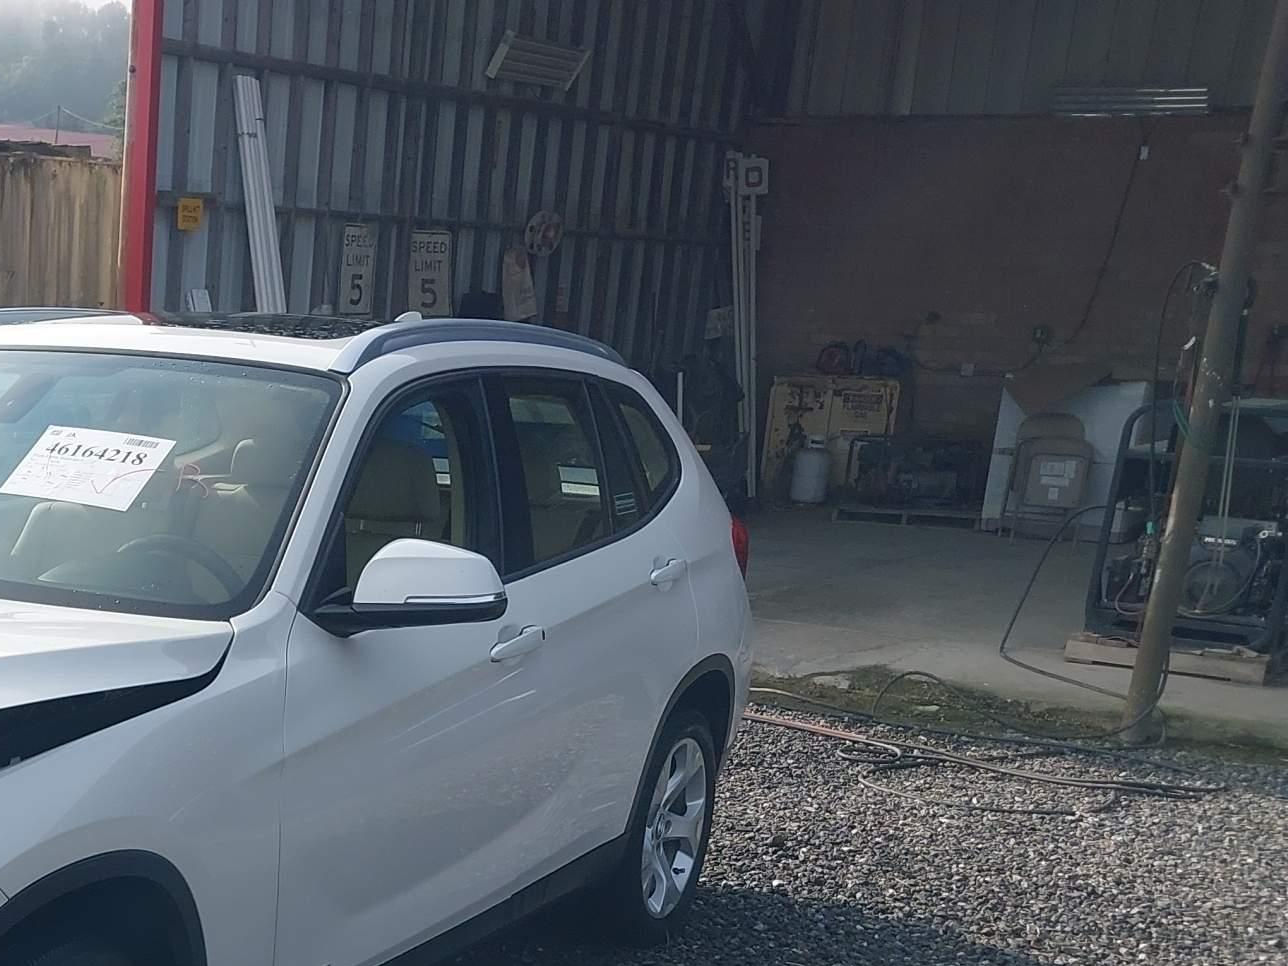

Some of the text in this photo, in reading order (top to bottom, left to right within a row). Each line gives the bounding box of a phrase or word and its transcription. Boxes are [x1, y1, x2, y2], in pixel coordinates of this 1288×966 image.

[412, 241, 448, 254] SPEED
[346, 254, 370, 267] LIMIT
[414, 260, 443, 272] LIMIT
[349, 273, 363, 306] 5
[421, 278, 437, 308] 5
[45, 441, 148, 466] 46164218
